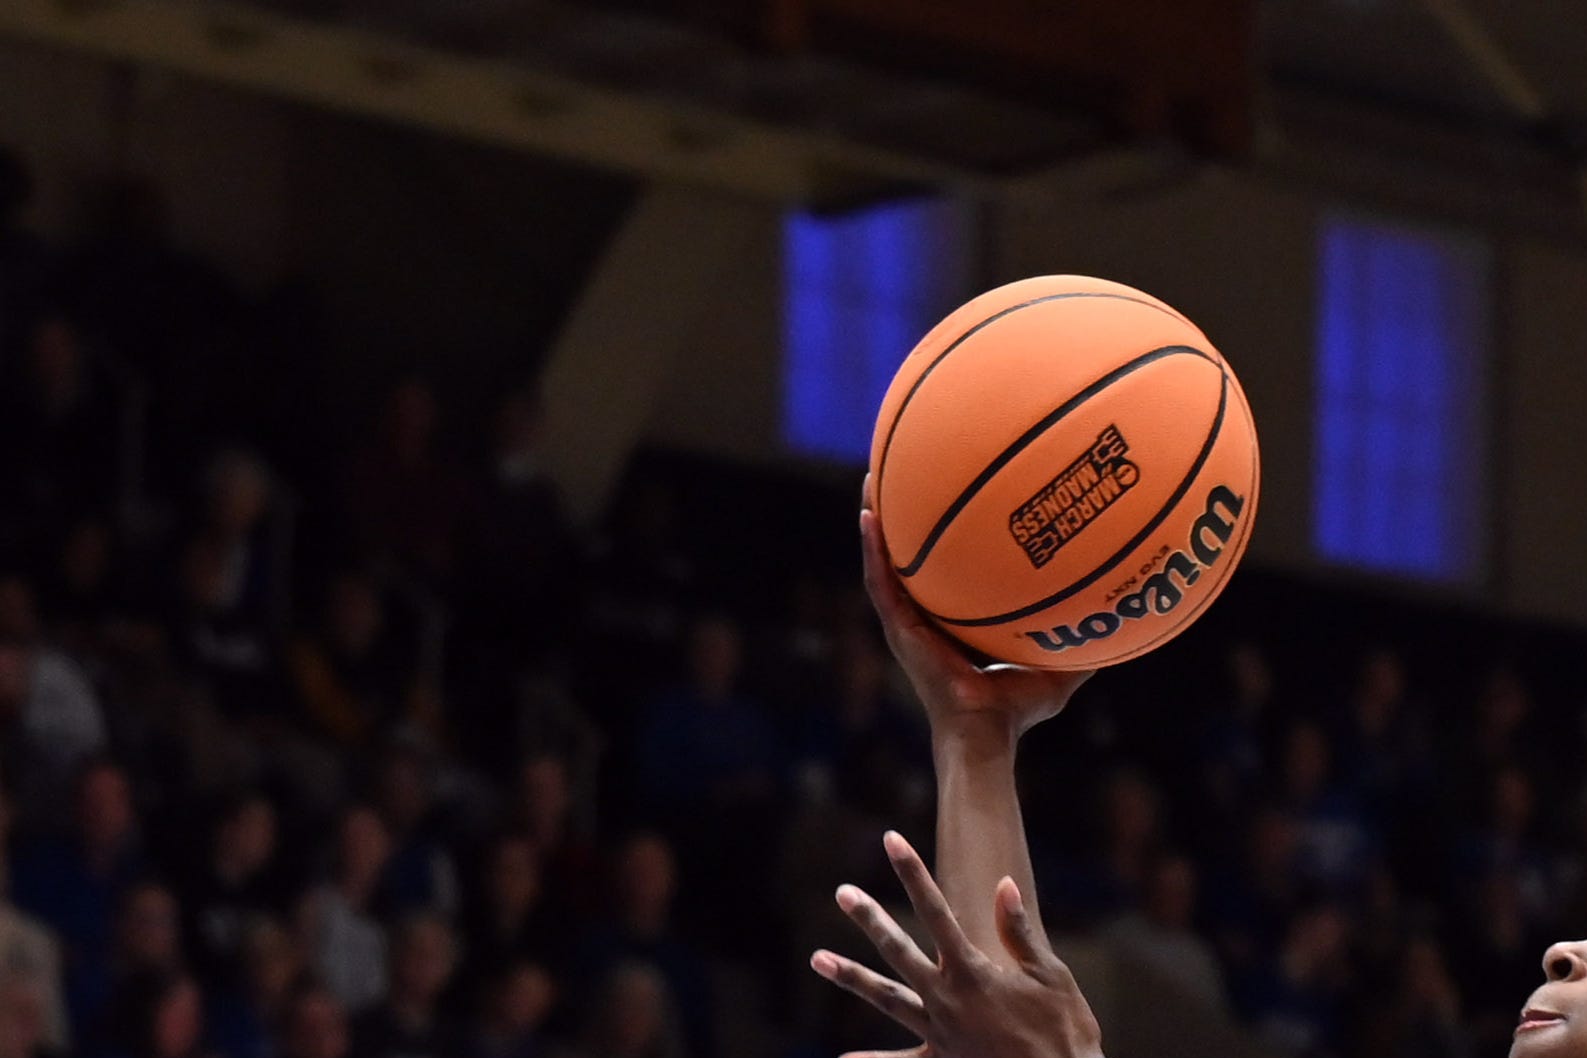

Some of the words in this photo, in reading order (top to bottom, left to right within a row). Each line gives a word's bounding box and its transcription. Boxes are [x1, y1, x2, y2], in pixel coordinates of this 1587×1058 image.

[1011, 460, 1100, 544] MADNESS
[1053, 473, 1122, 540] MARCH
[1024, 484, 1245, 652] Wilson
